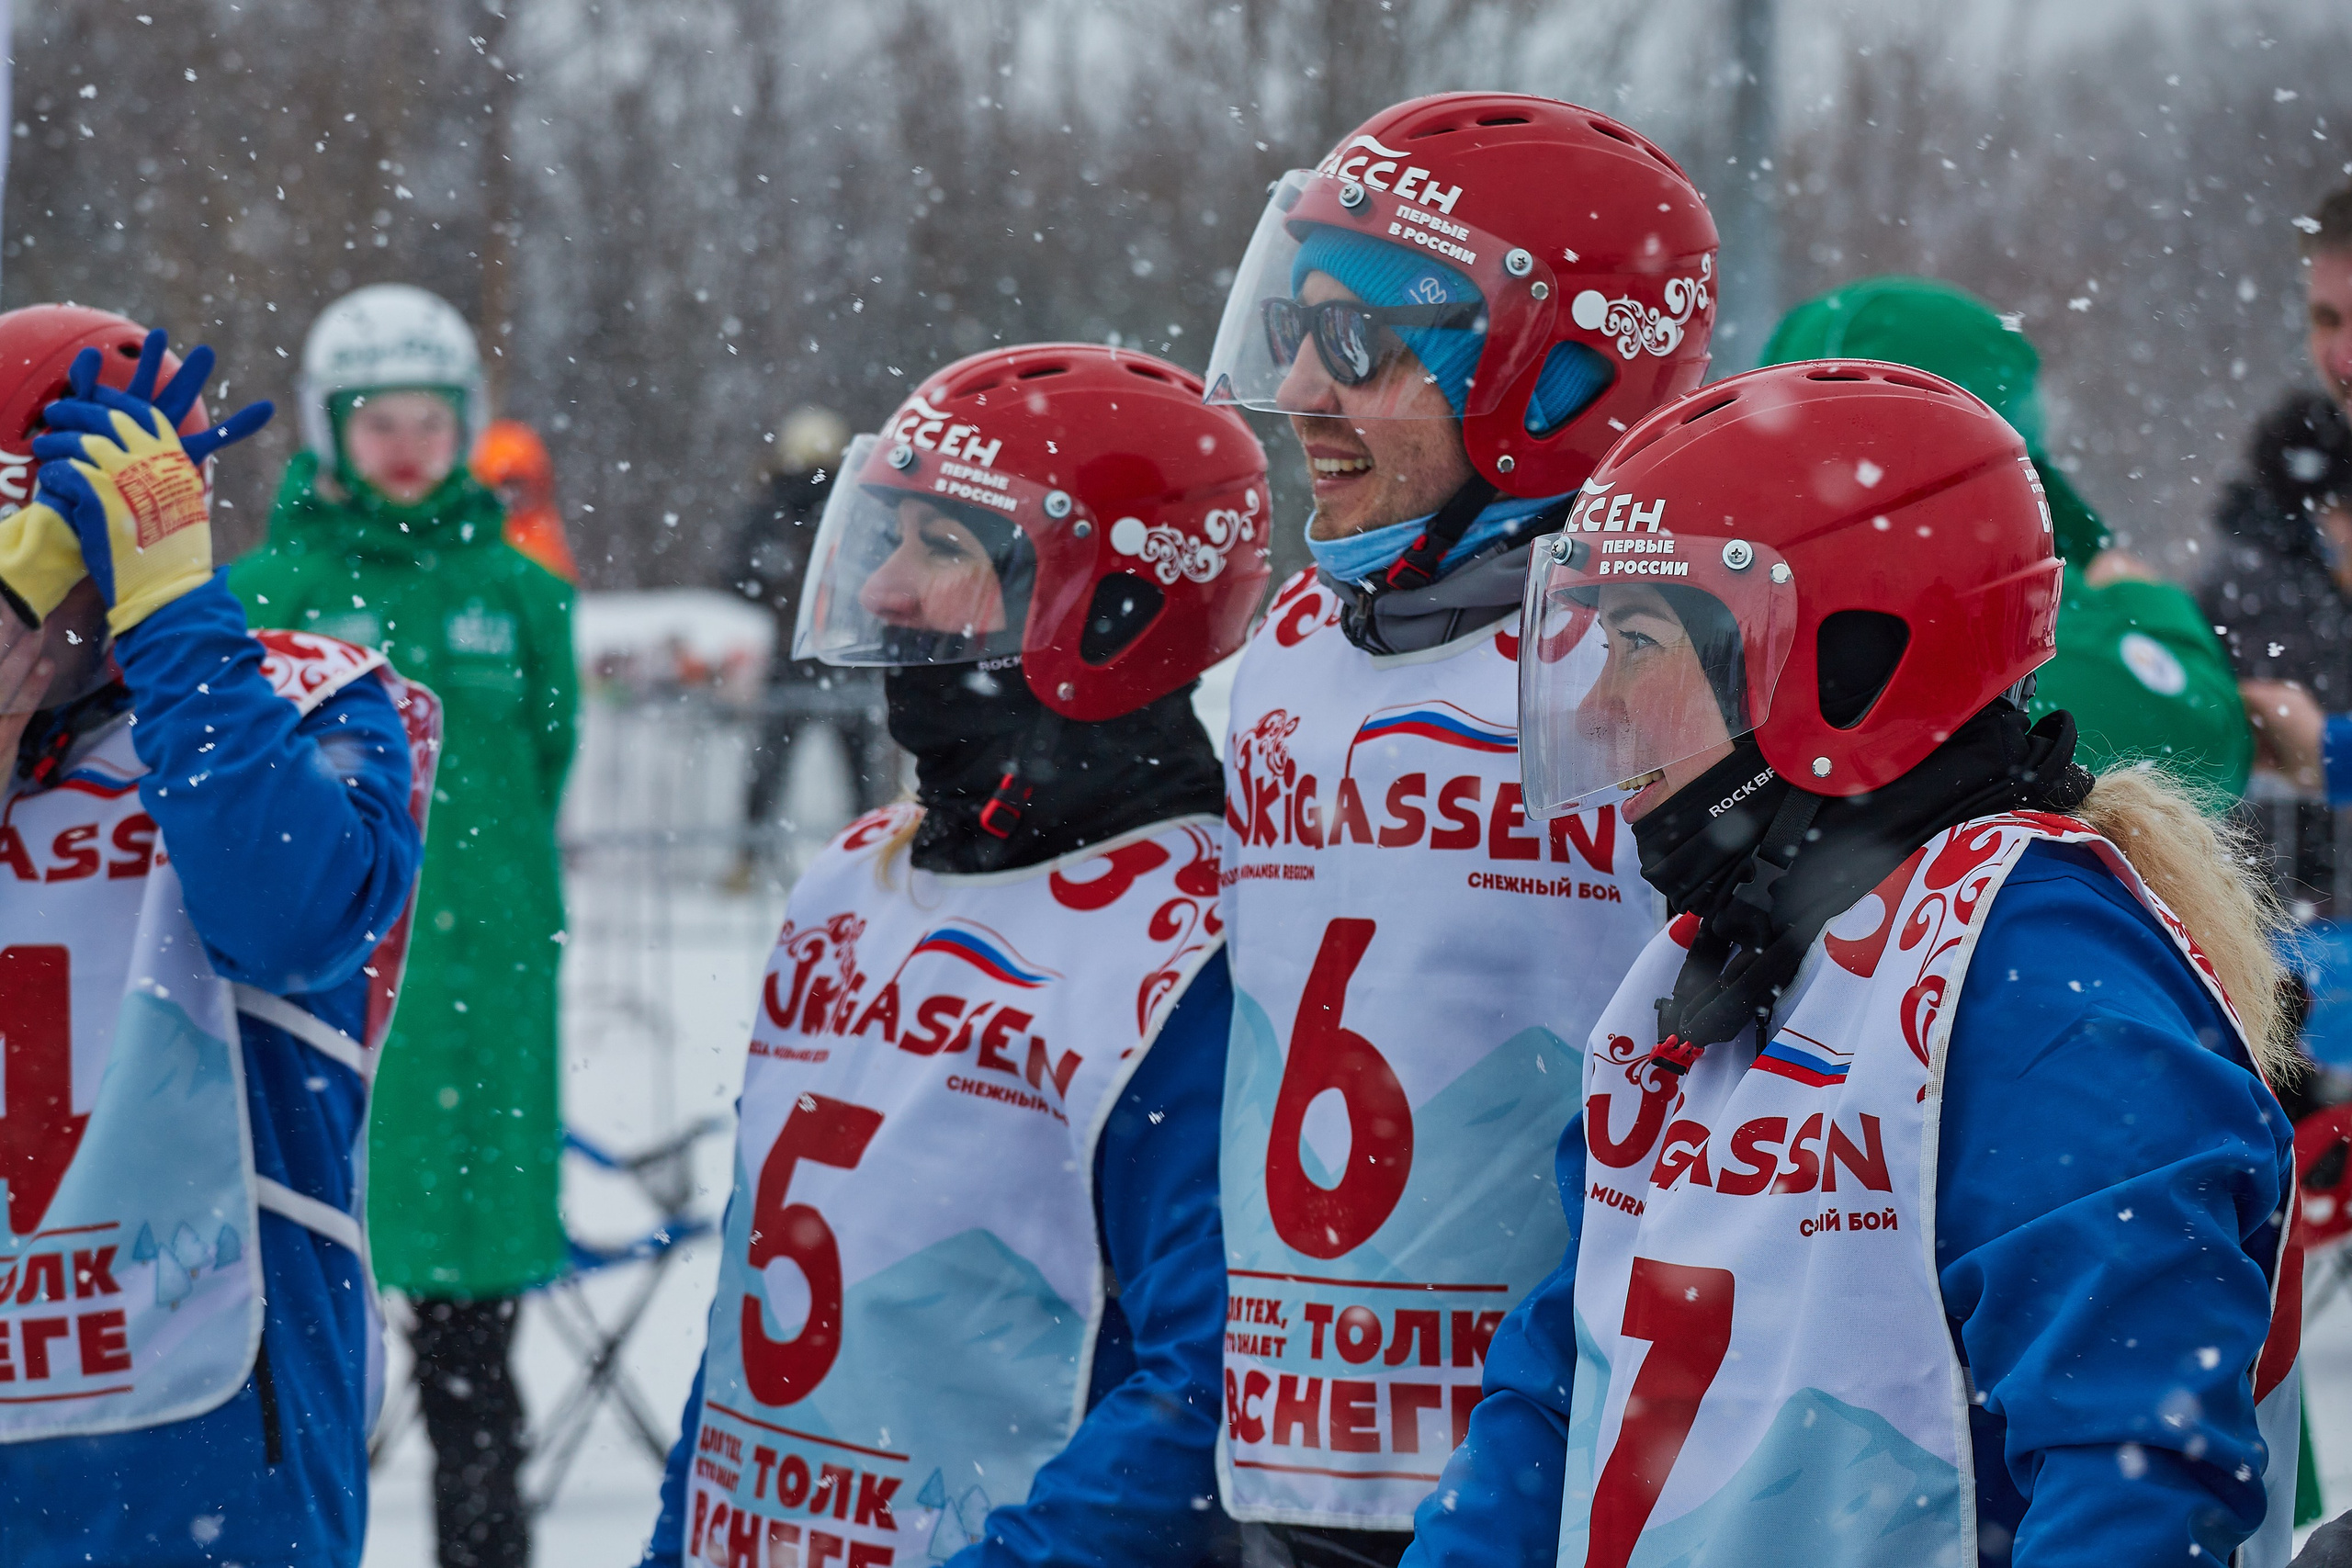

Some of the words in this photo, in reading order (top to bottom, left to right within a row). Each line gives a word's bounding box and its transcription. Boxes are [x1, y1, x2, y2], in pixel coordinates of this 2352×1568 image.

[1396, 204, 1470, 242] ПЕРВЫЕ
[1387, 221, 1403, 236] В
[1403, 227, 1477, 265] РОССИИ
[940, 461, 1010, 491] ПЕРВЫЕ
[934, 478, 948, 492] В
[948, 480, 1018, 513] РОССИИ
[1601, 538, 1675, 554] ПЕРВЫЕ
[1599, 560, 1611, 575] В
[1612, 559, 1689, 576] РОССИИ
[1467, 871, 1572, 898] СНЕЖНЫЙ
[1578, 882, 1623, 903] БОЙ
[1264, 917, 1414, 1259] 6
[1849, 1207, 1898, 1232] БОЙ
[741, 1092, 886, 1409] 5
[1246, 1296, 1288, 1330] ТЕХ,
[1305, 1302, 1506, 1368] ТОЛК
[1584, 1257, 1736, 1568] 7
[753, 1444, 903, 1531] ТОЛК
